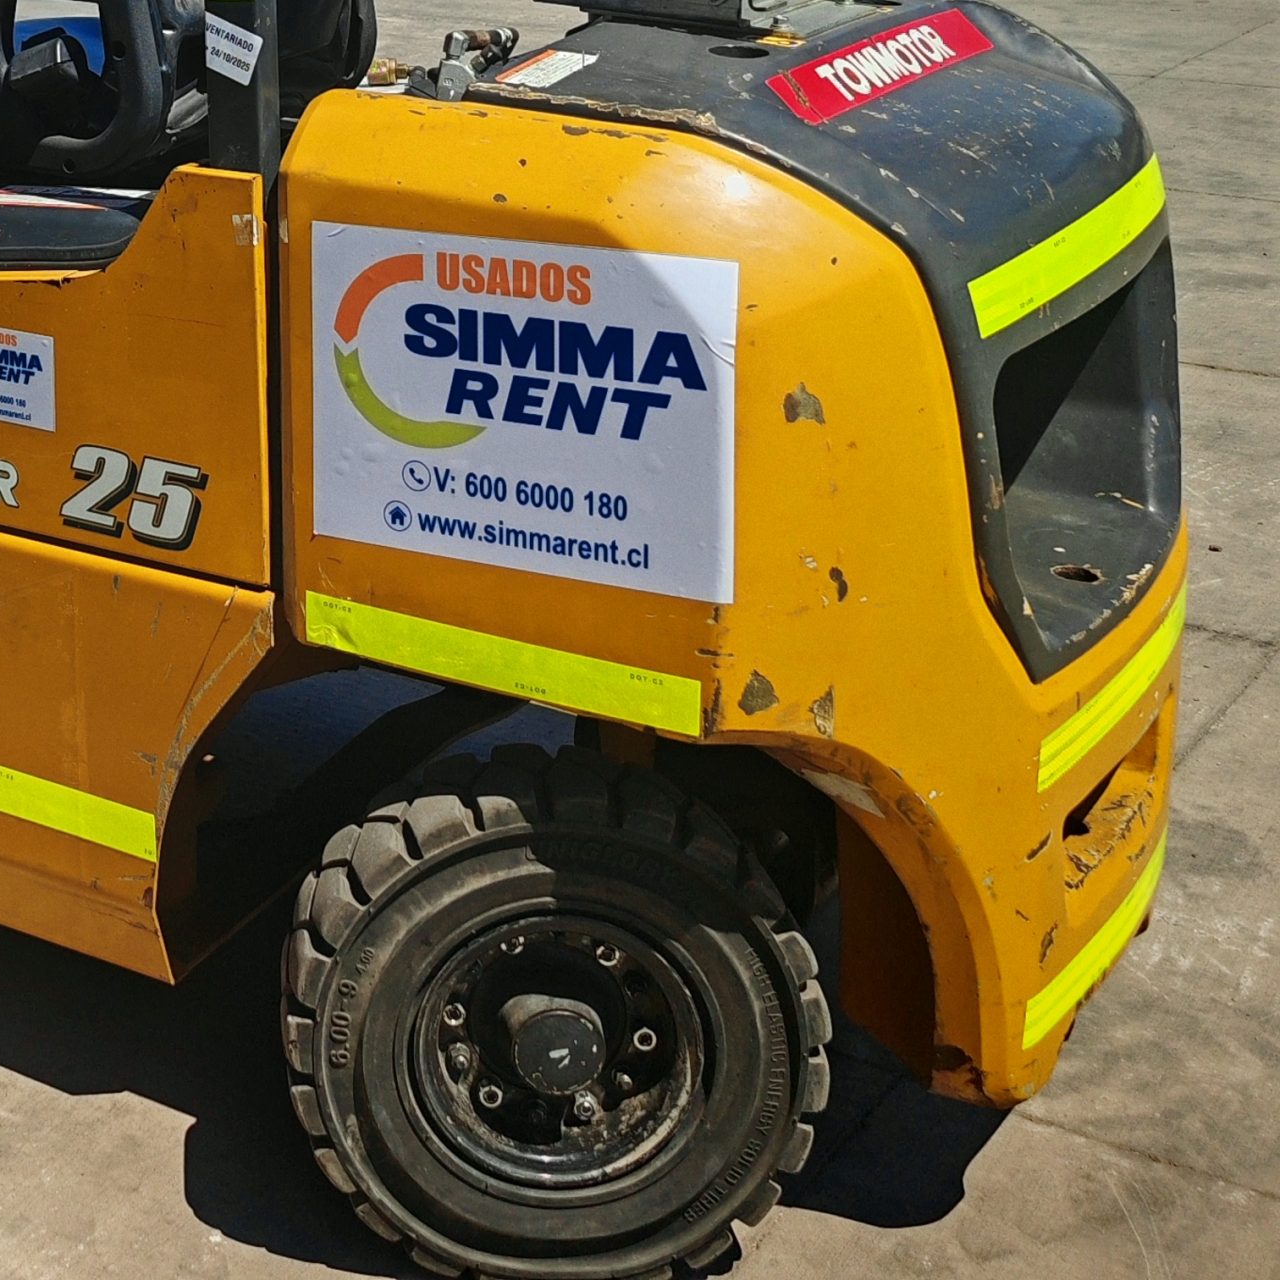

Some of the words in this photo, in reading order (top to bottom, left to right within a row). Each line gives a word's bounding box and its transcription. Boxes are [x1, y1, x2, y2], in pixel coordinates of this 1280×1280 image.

[210, 46, 251, 72] 24/10/2025
[815, 25, 956, 101] TOWMOTOR
[436, 252, 592, 306] USADOS
[404, 303, 708, 392] SIMMA
[445, 368, 671, 441] RENT
[60, 444, 209, 551] 25
[433, 466, 456, 494] V:
[465, 472, 507, 502] 600
[515, 480, 574, 512] 6000
[583, 491, 628, 521] 180
[418, 511, 649, 569] www.simmarent.cl
[744, 947, 772, 986] HIGH
[328, 979, 359, 1070] 6.00-9
[762, 991, 787, 1062] ELASTIC
[756, 1068, 786, 1136] ENERGY
[724, 1138, 763, 1187] SOLID
